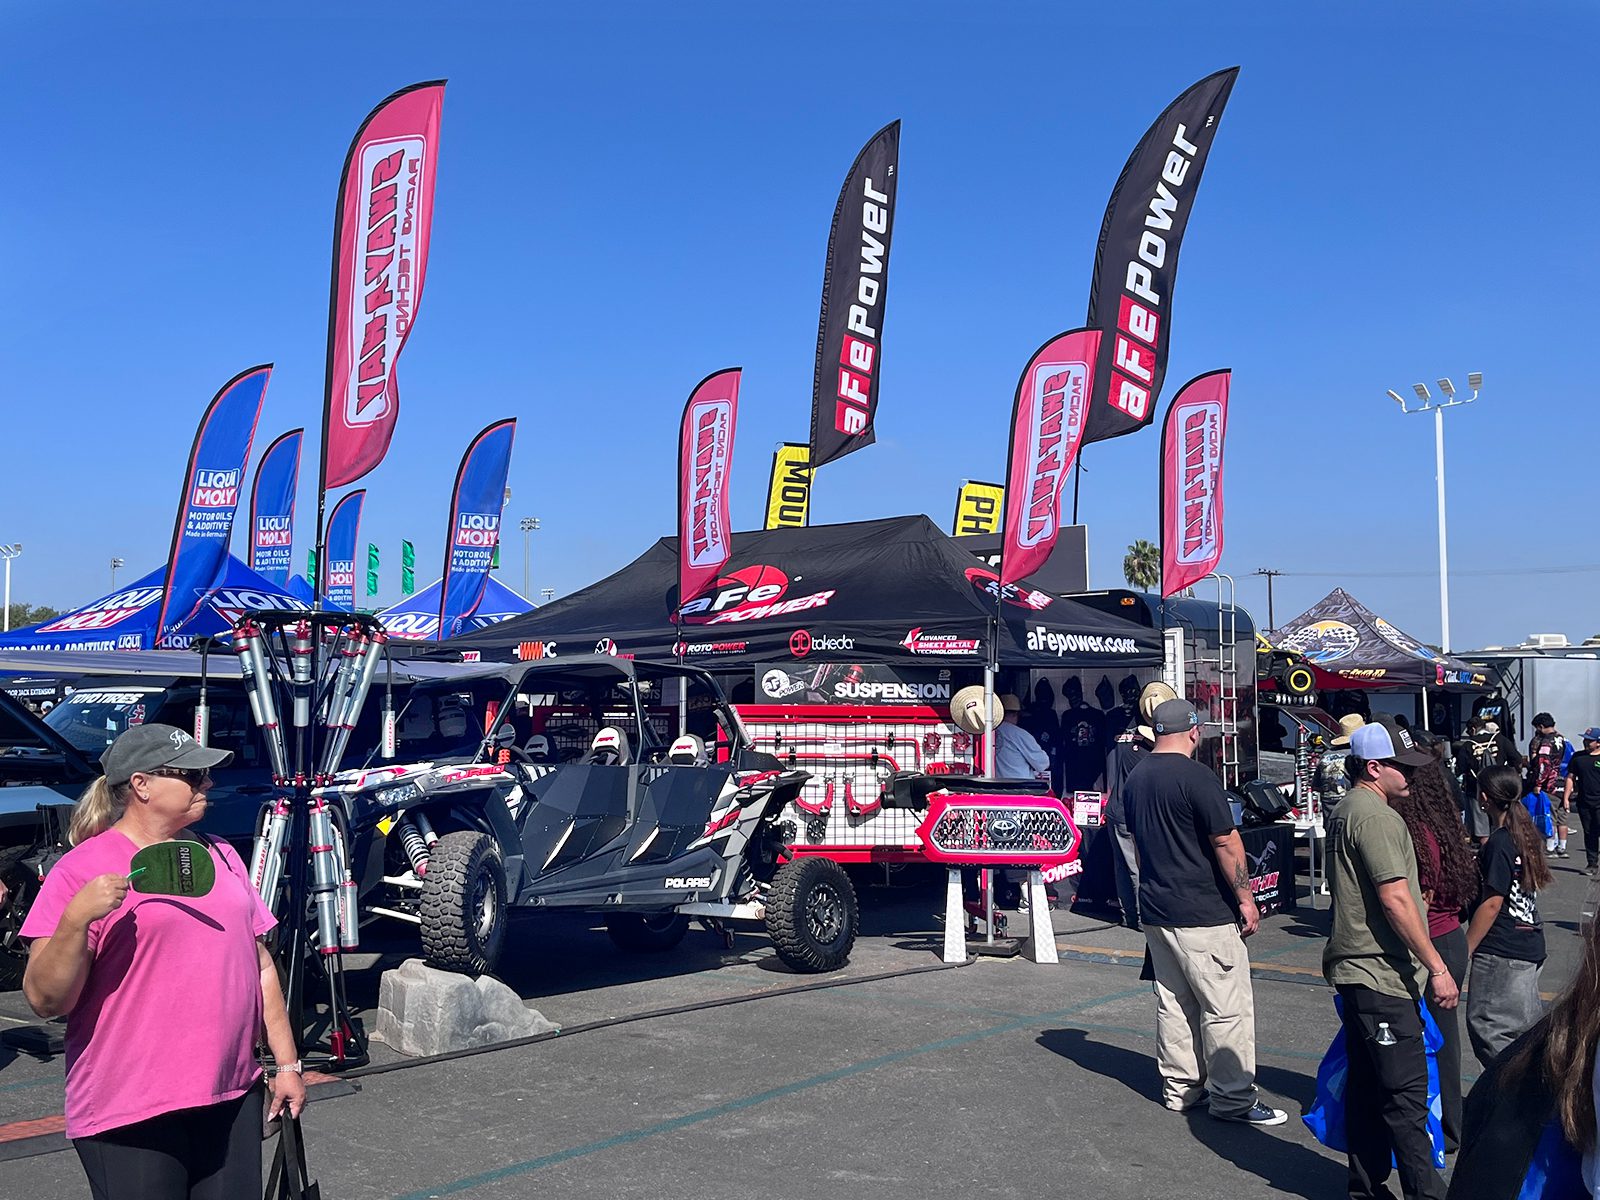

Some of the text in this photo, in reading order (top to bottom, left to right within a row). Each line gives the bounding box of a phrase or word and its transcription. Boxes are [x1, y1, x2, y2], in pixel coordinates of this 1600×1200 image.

[198, 471, 236, 488] LIQUI
[195, 488, 236, 505] MOLY
[777, 460, 811, 528] MOU
[189, 511, 233, 521] MOTOR OILS
[187, 521, 231, 530] & ADDITIVE
[259, 532, 288, 545] MOLY
[457, 530, 497, 545] MOLY
[453, 550, 477, 558] MOTOR
[330, 562, 353, 573] LIQU
[330, 573, 353, 585] MOL
[680, 585, 782, 615] aFe
[706, 589, 837, 625] POWER
[161, 636, 193, 649] LIQU
[812, 634, 853, 650] takeda
[1027, 626, 1140, 657] aFepower.com
[834, 682, 951, 698] SUSPENSION
[97, 694, 144, 704] TIRES
[442, 765, 505, 783] TURBO
[179, 846, 191, 876] RHINO
[664, 877, 710, 888] POLARIS
